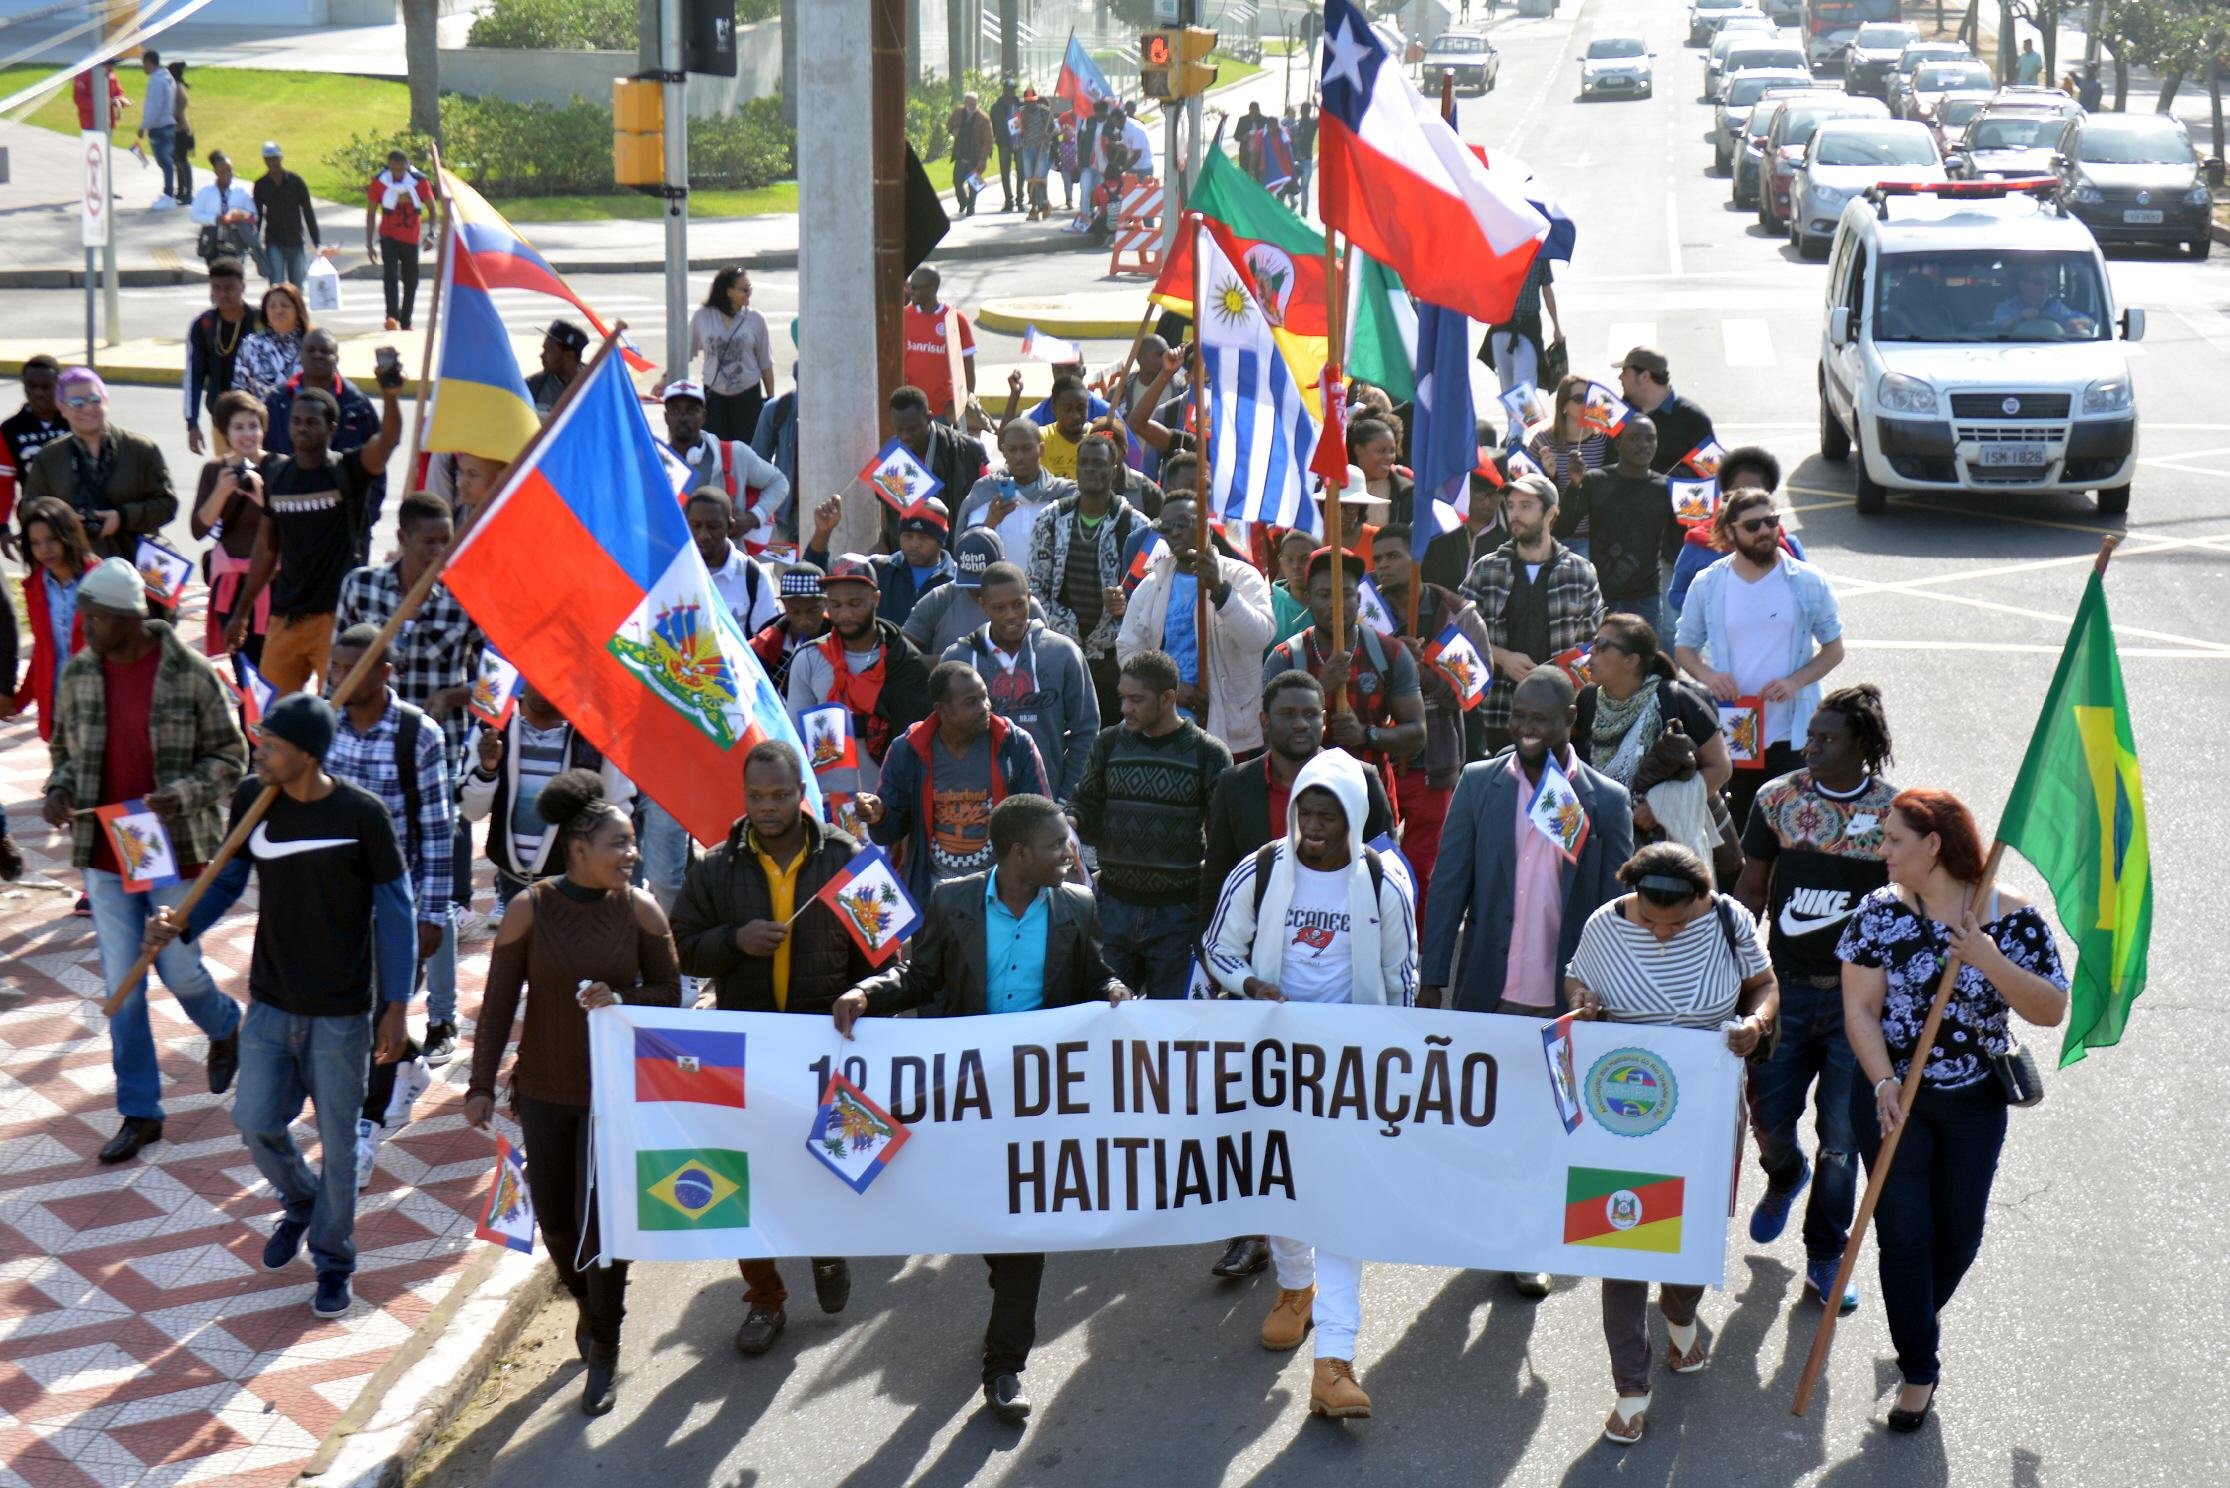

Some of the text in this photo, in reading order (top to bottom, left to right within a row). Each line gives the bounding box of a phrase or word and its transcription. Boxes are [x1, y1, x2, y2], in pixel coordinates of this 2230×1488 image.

[273, 496, 336, 513] STRANGER
[960, 550, 986, 562] John
[960, 560, 987, 572] John
[1791, 886, 1852, 917] NIKE
[1284, 908, 1351, 932] CCANEE
[890, 1048, 993, 1125] DIA
[1012, 1040, 1090, 1118] DE
[1112, 1034, 1499, 1138] INTEGRAÇÃO
[1007, 1128, 1297, 1215] HAITIANA
